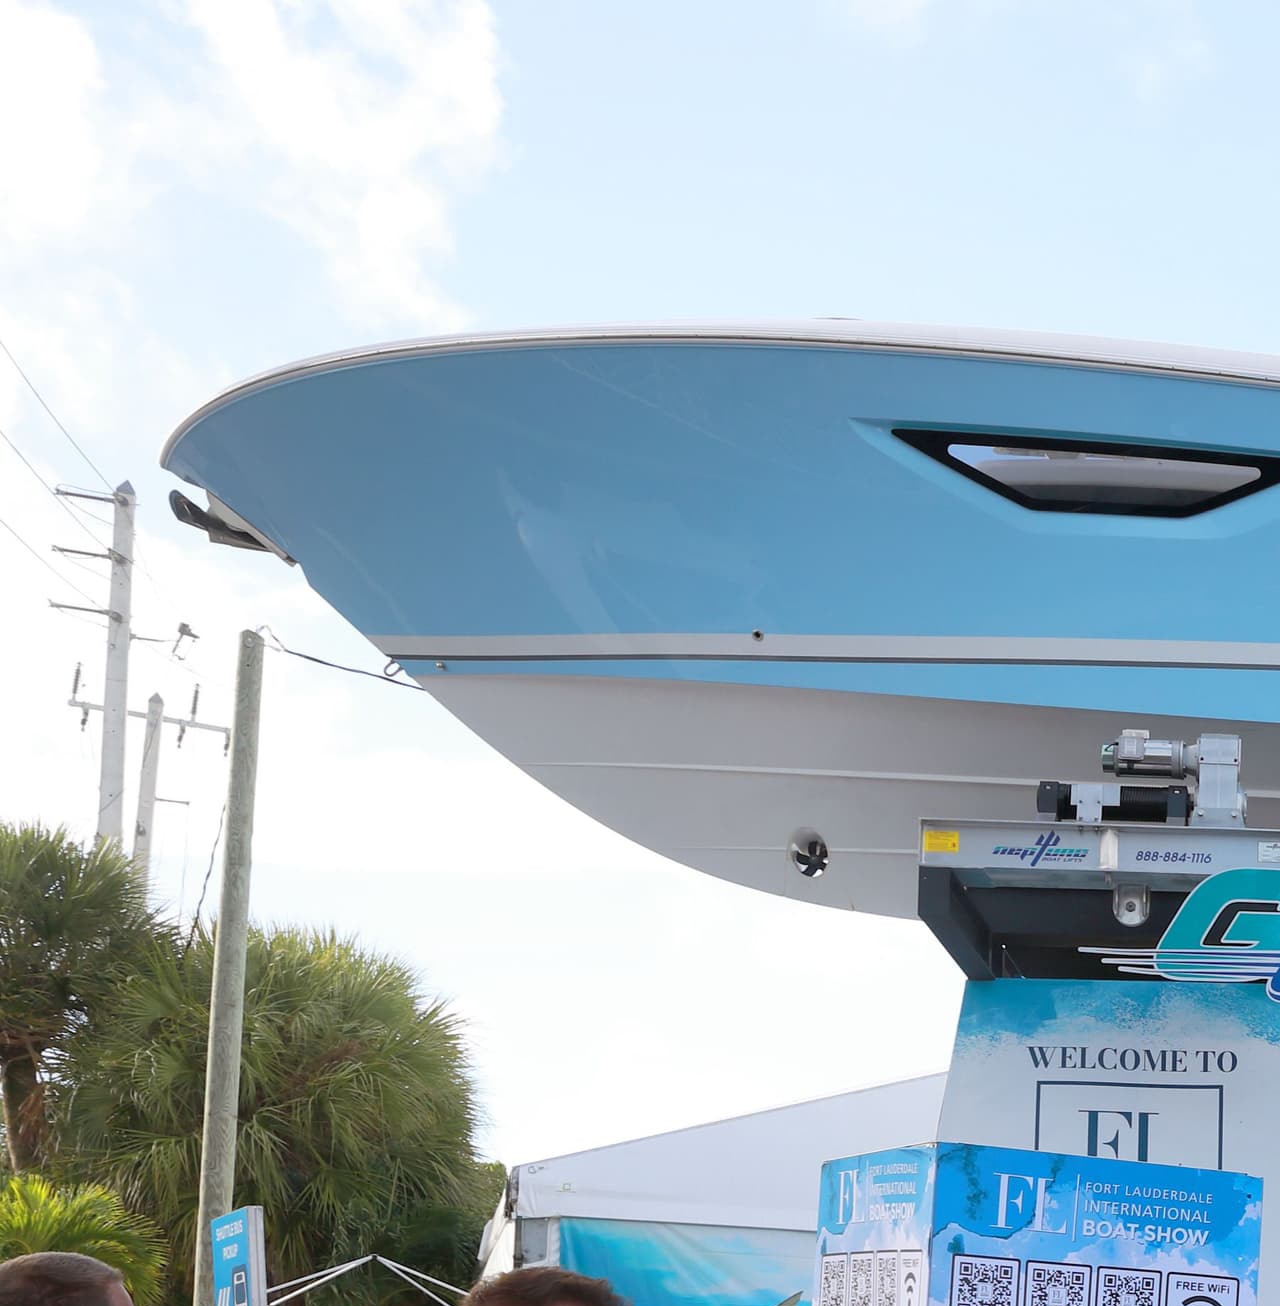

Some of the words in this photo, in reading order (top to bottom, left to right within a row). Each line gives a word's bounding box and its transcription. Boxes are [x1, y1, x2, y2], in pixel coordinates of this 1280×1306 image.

[1135, 850, 1212, 864] 888-884-1116
[1026, 1046, 1188, 1073] WELCOME
[1195, 1050, 1238, 1074] TO
[836, 1168, 864, 1225] FL
[989, 1172, 1067, 1235] FL
[1085, 1182, 1121, 1195] FORT
[1125, 1186, 1213, 1204] LAUDERDALE
[869, 1203, 891, 1221] BOAT
[891, 1202, 916, 1218] SHOW
[1083, 1199, 1212, 1224] INTERNATIONAL
[1082, 1219, 1139, 1240] BOAT
[1143, 1227, 1210, 1247] SHOW
[1176, 1280, 1205, 1292] FREE
[1208, 1283, 1231, 1294] WiFi
